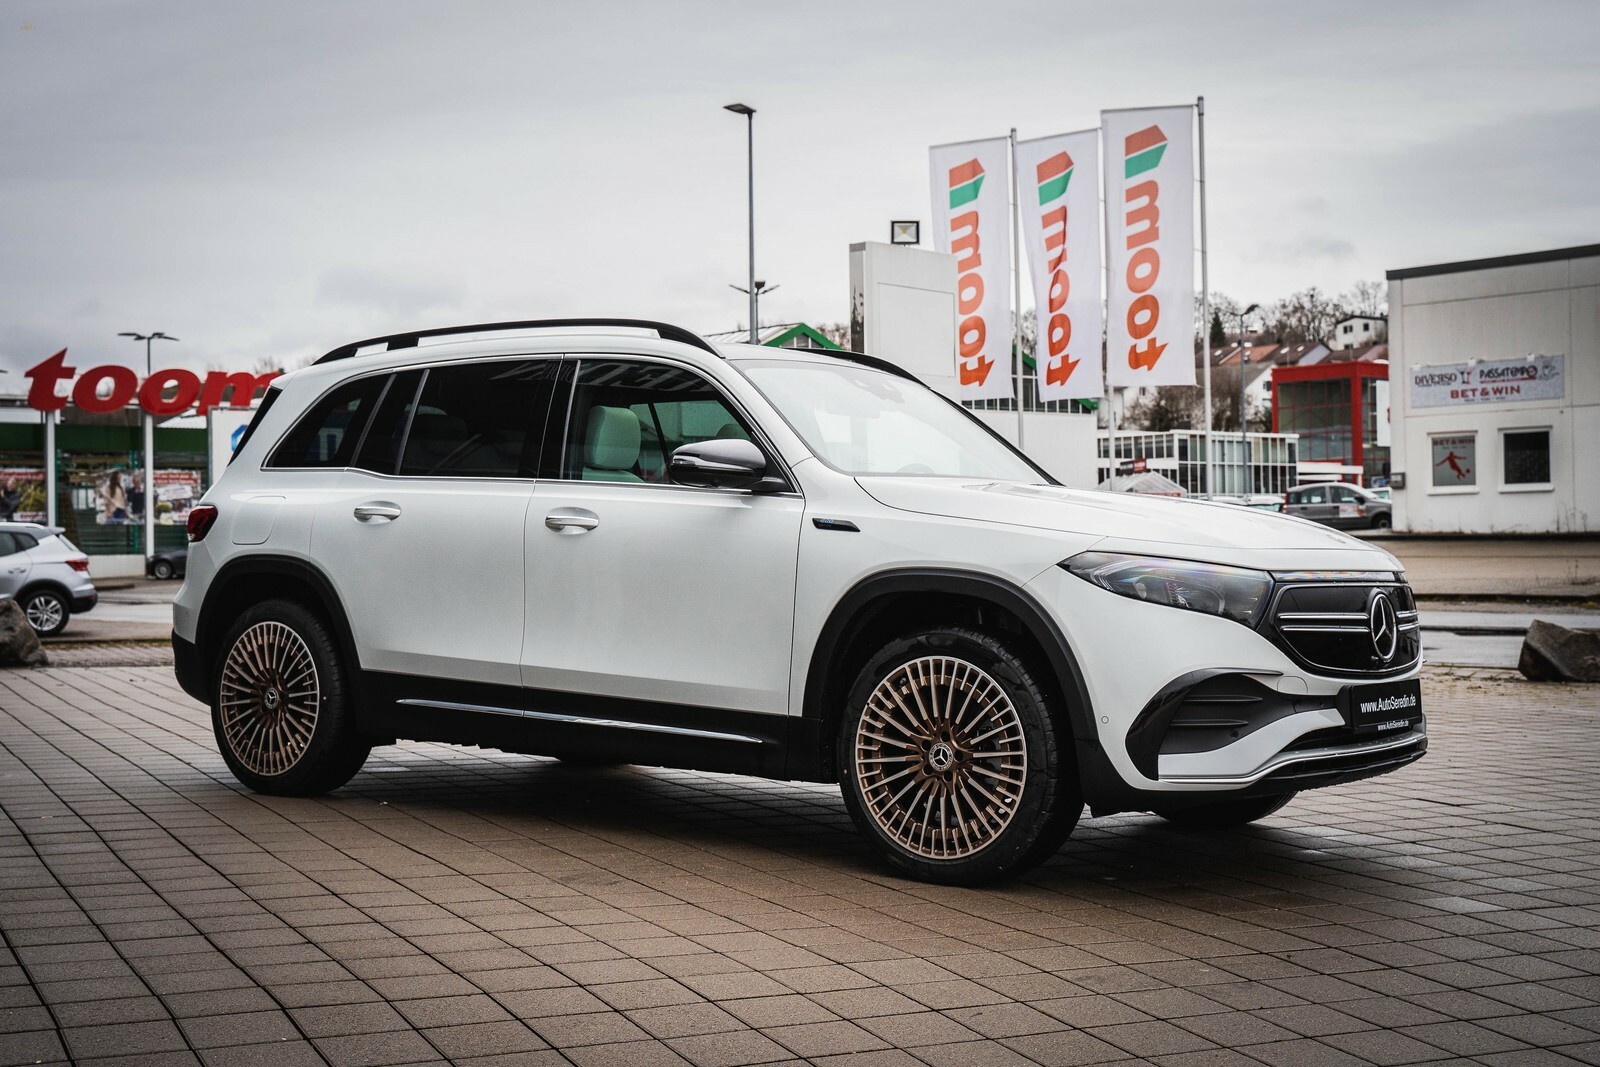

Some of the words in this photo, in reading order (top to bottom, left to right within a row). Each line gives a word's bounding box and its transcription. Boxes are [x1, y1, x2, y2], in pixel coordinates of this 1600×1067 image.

[1450, 388, 1478, 399] BET
[1480, 387, 1489, 397] &
[1492, 385, 1521, 396] WIN
[1360, 693, 1417, 713] www.AutoSeredin.de
